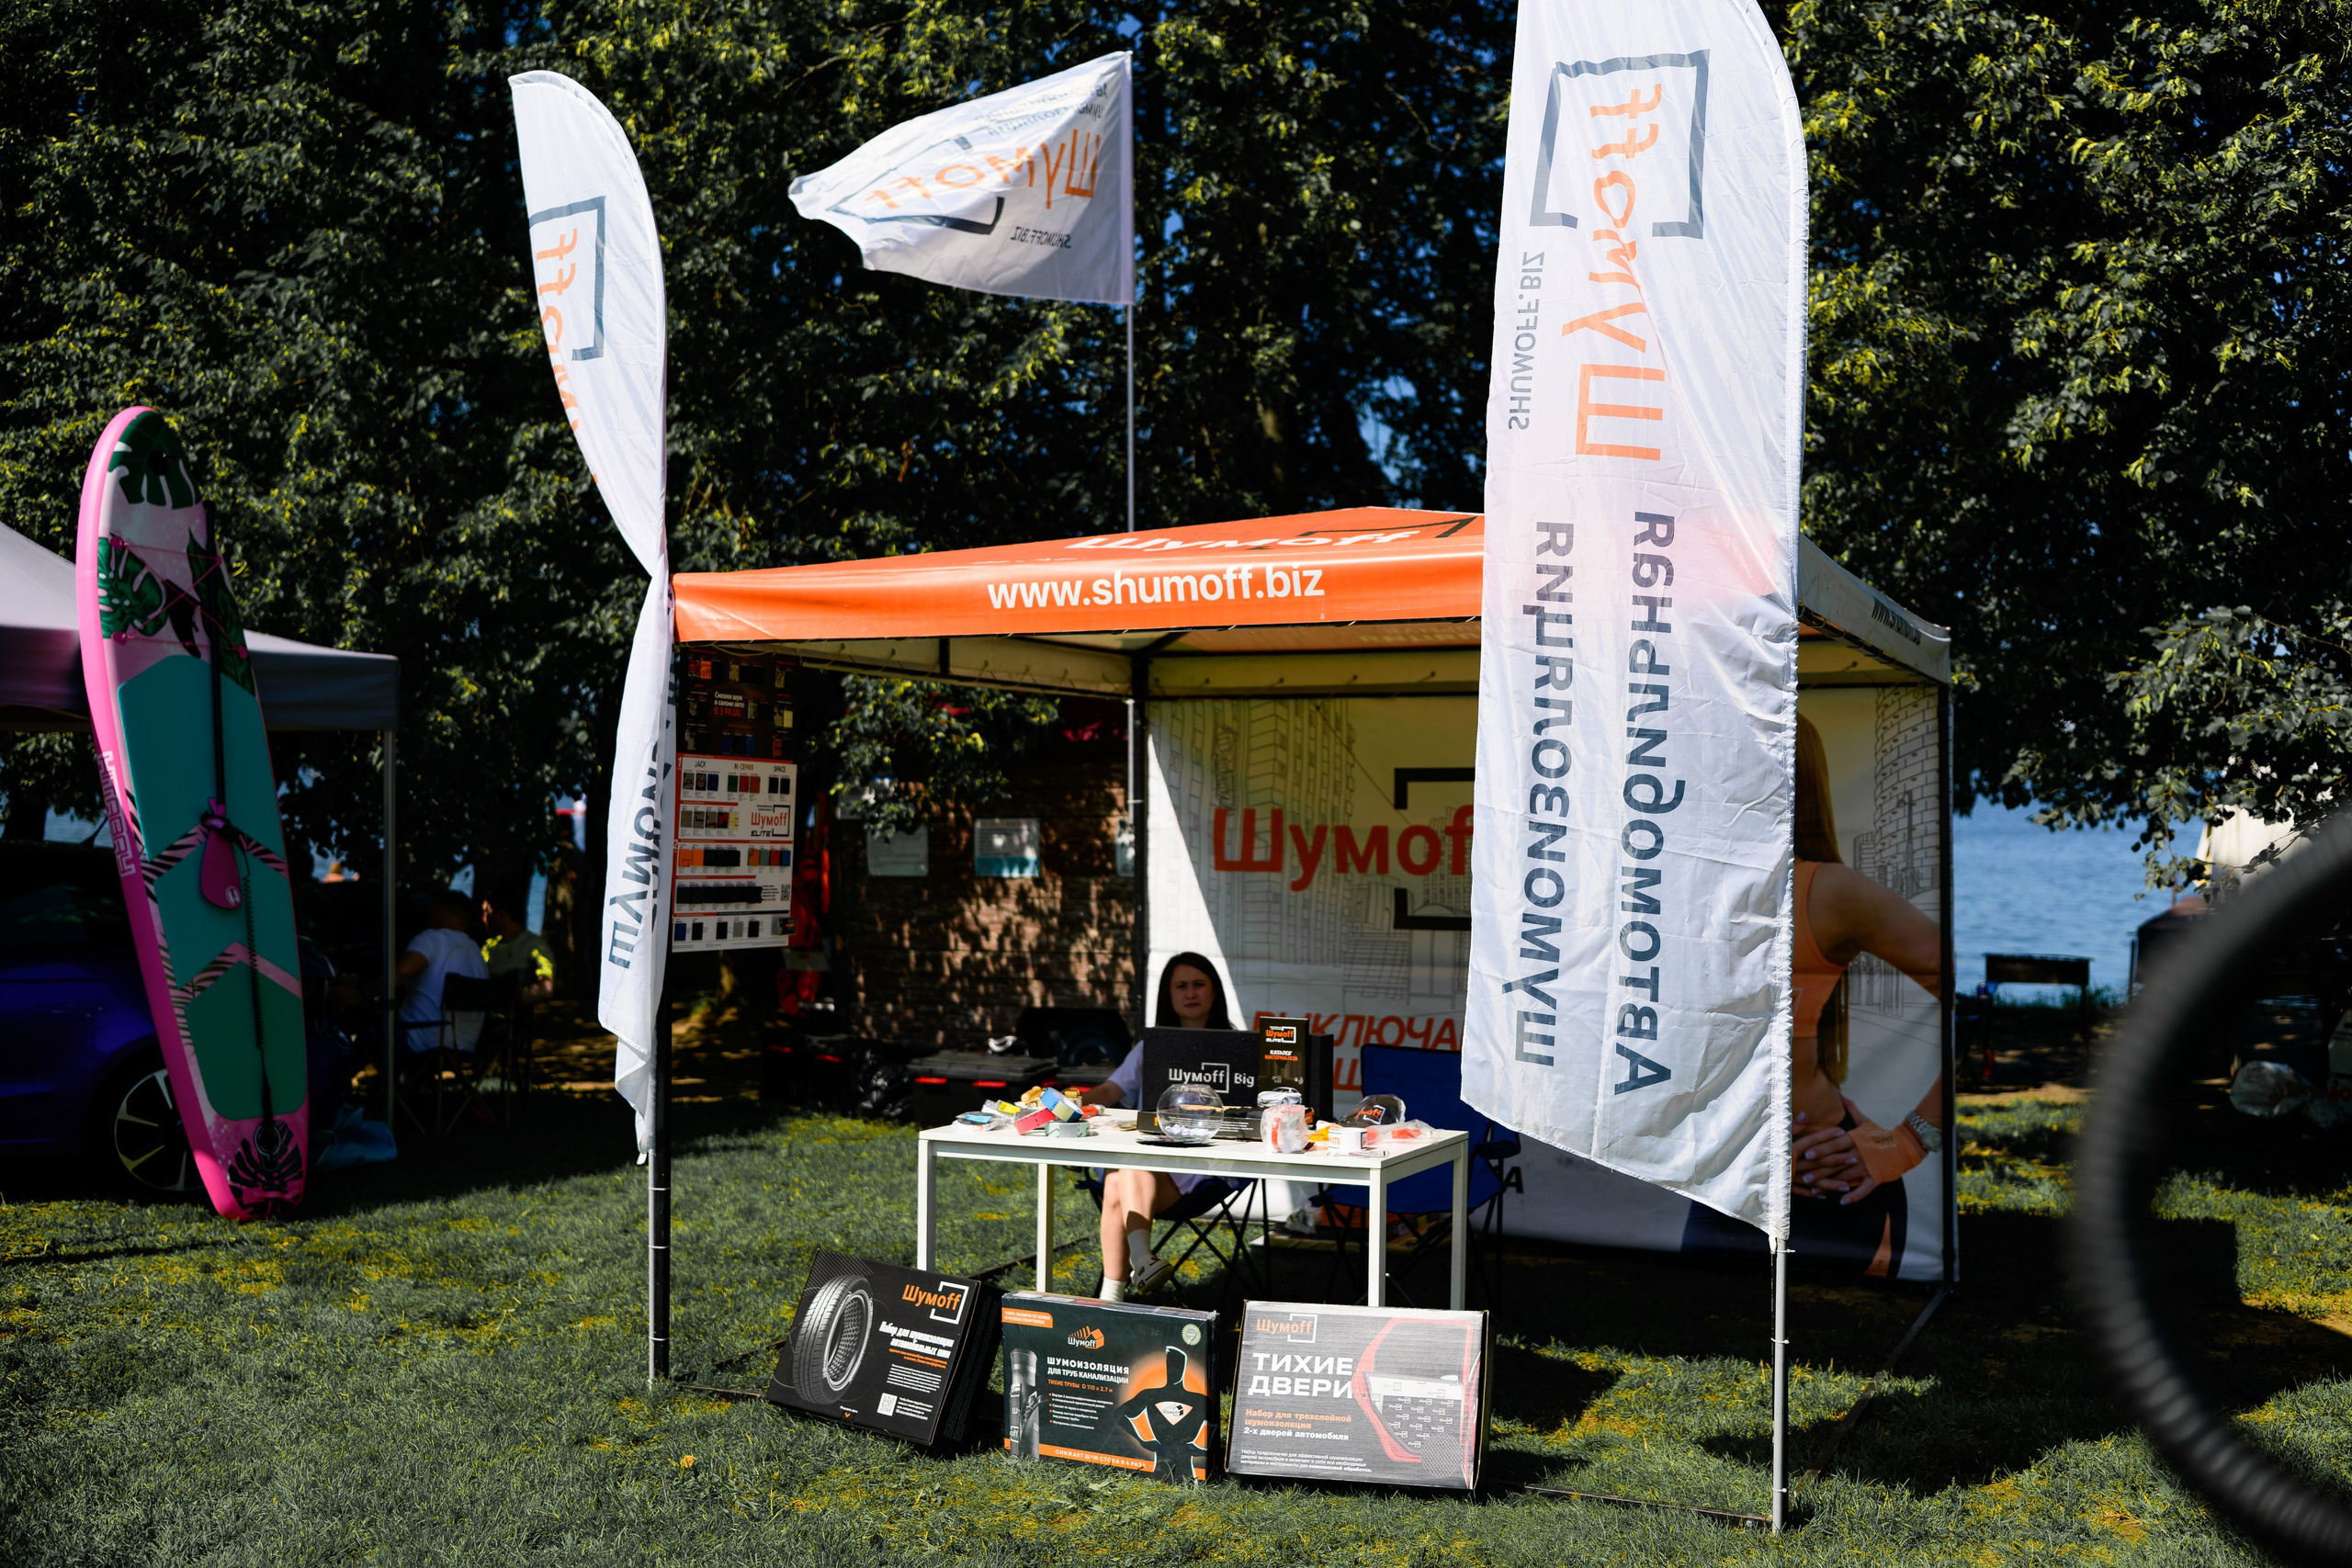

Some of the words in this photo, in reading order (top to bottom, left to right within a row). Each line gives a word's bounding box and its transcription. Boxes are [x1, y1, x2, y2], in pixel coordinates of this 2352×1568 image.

[988, 562, 1325, 610] www.shumoff.biz
[774, 765, 786, 773] SPACE
[1213, 804, 1474, 892] Шумof
[1234, 1072, 1255, 1088] Big
[1047, 1356, 1129, 1374] ШУМОИЗОЛЯЦИЯ
[1252, 1352, 1353, 1376] ТИХИЕ
[1047, 1367, 1061, 1375] ДЛЯ
[1062, 1369, 1079, 1377] ТРУБ
[1079, 1371, 1128, 1384] КАНАЛИЗАЦИИ
[1248, 1376, 1353, 1399] ДВЕРИ
[1244, 1418, 1312, 1429] шумоизоляции
[1245, 1409, 1273, 1418] Набор
[1295, 1413, 1352, 1422] трехслойной
[1243, 1427, 1259, 1435] 2-х
[1260, 1429, 1293, 1438] дверей
[1295, 1431, 1349, 1440] автомобиля
[1055, 1450, 1084, 1459] СНИЖАЕТ
